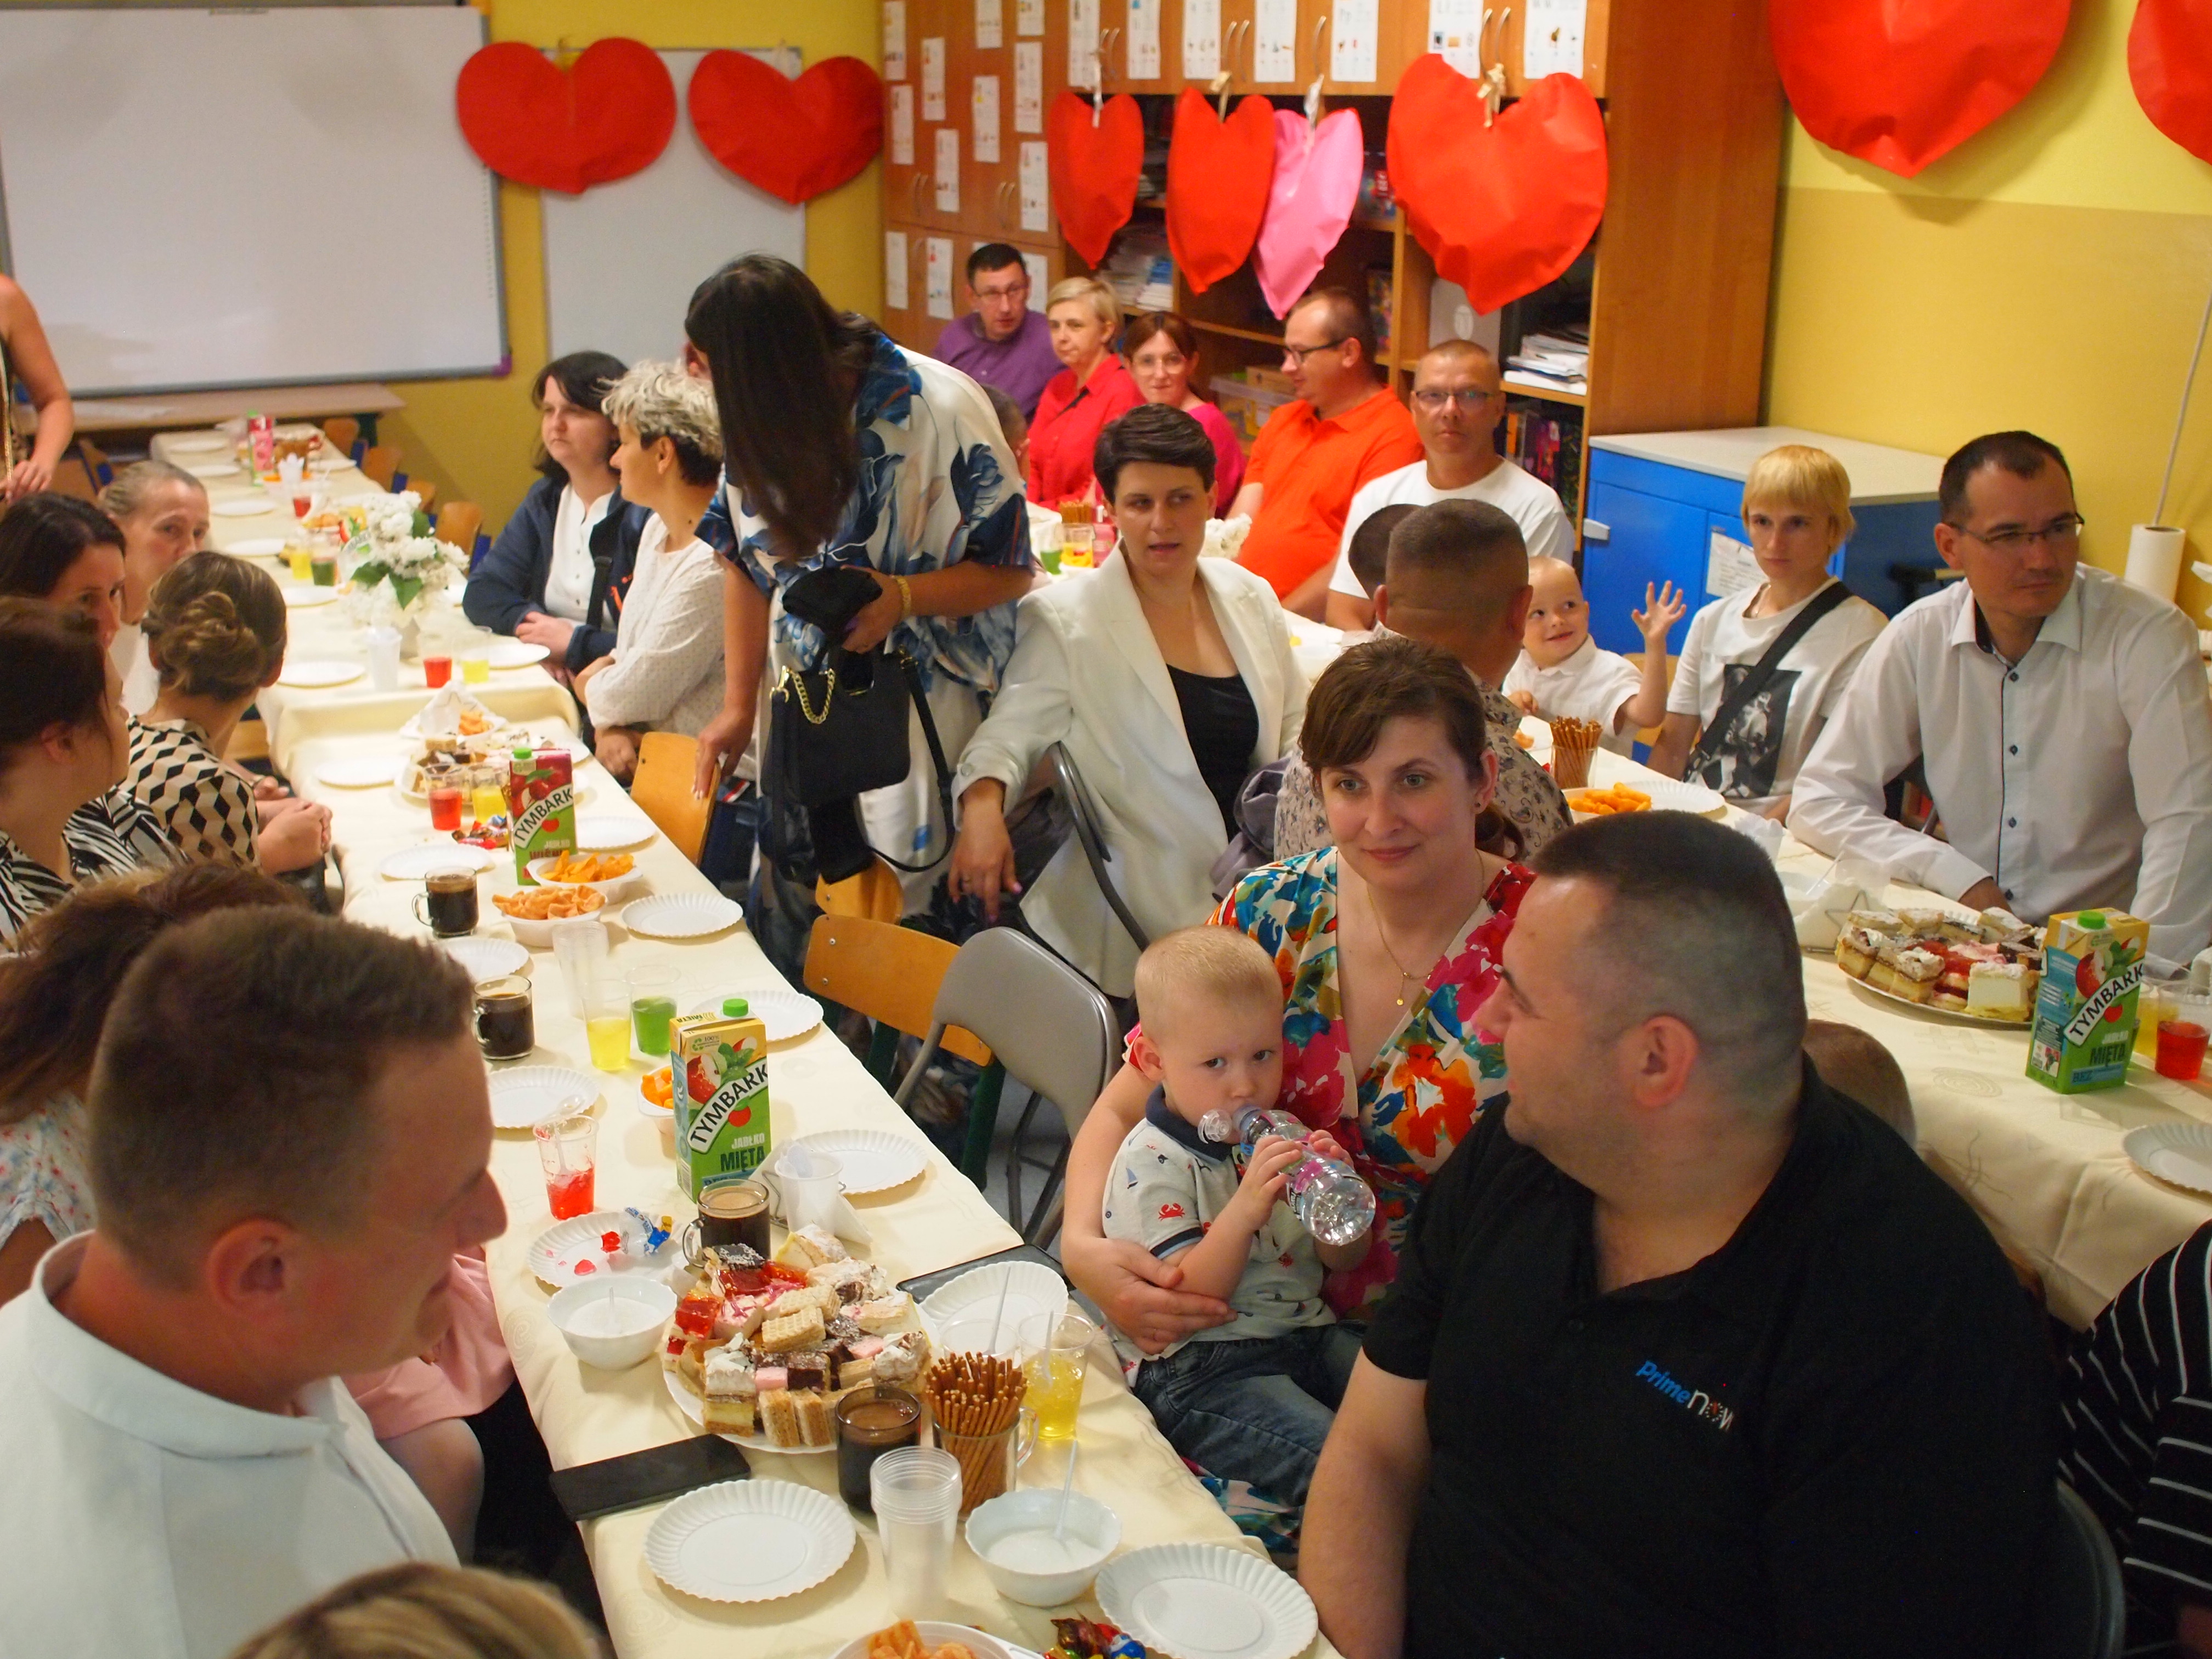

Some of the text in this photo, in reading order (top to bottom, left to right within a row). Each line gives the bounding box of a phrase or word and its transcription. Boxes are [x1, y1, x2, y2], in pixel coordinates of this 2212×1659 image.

[515, 787, 573, 842] TYMBARK
[2069, 963, 2145, 1038] TYMBARK
[690, 1063, 768, 1148] TYMBARK
[720, 1146, 765, 1172] MIĘTA
[731, 1133, 765, 1149] JABŁKO
